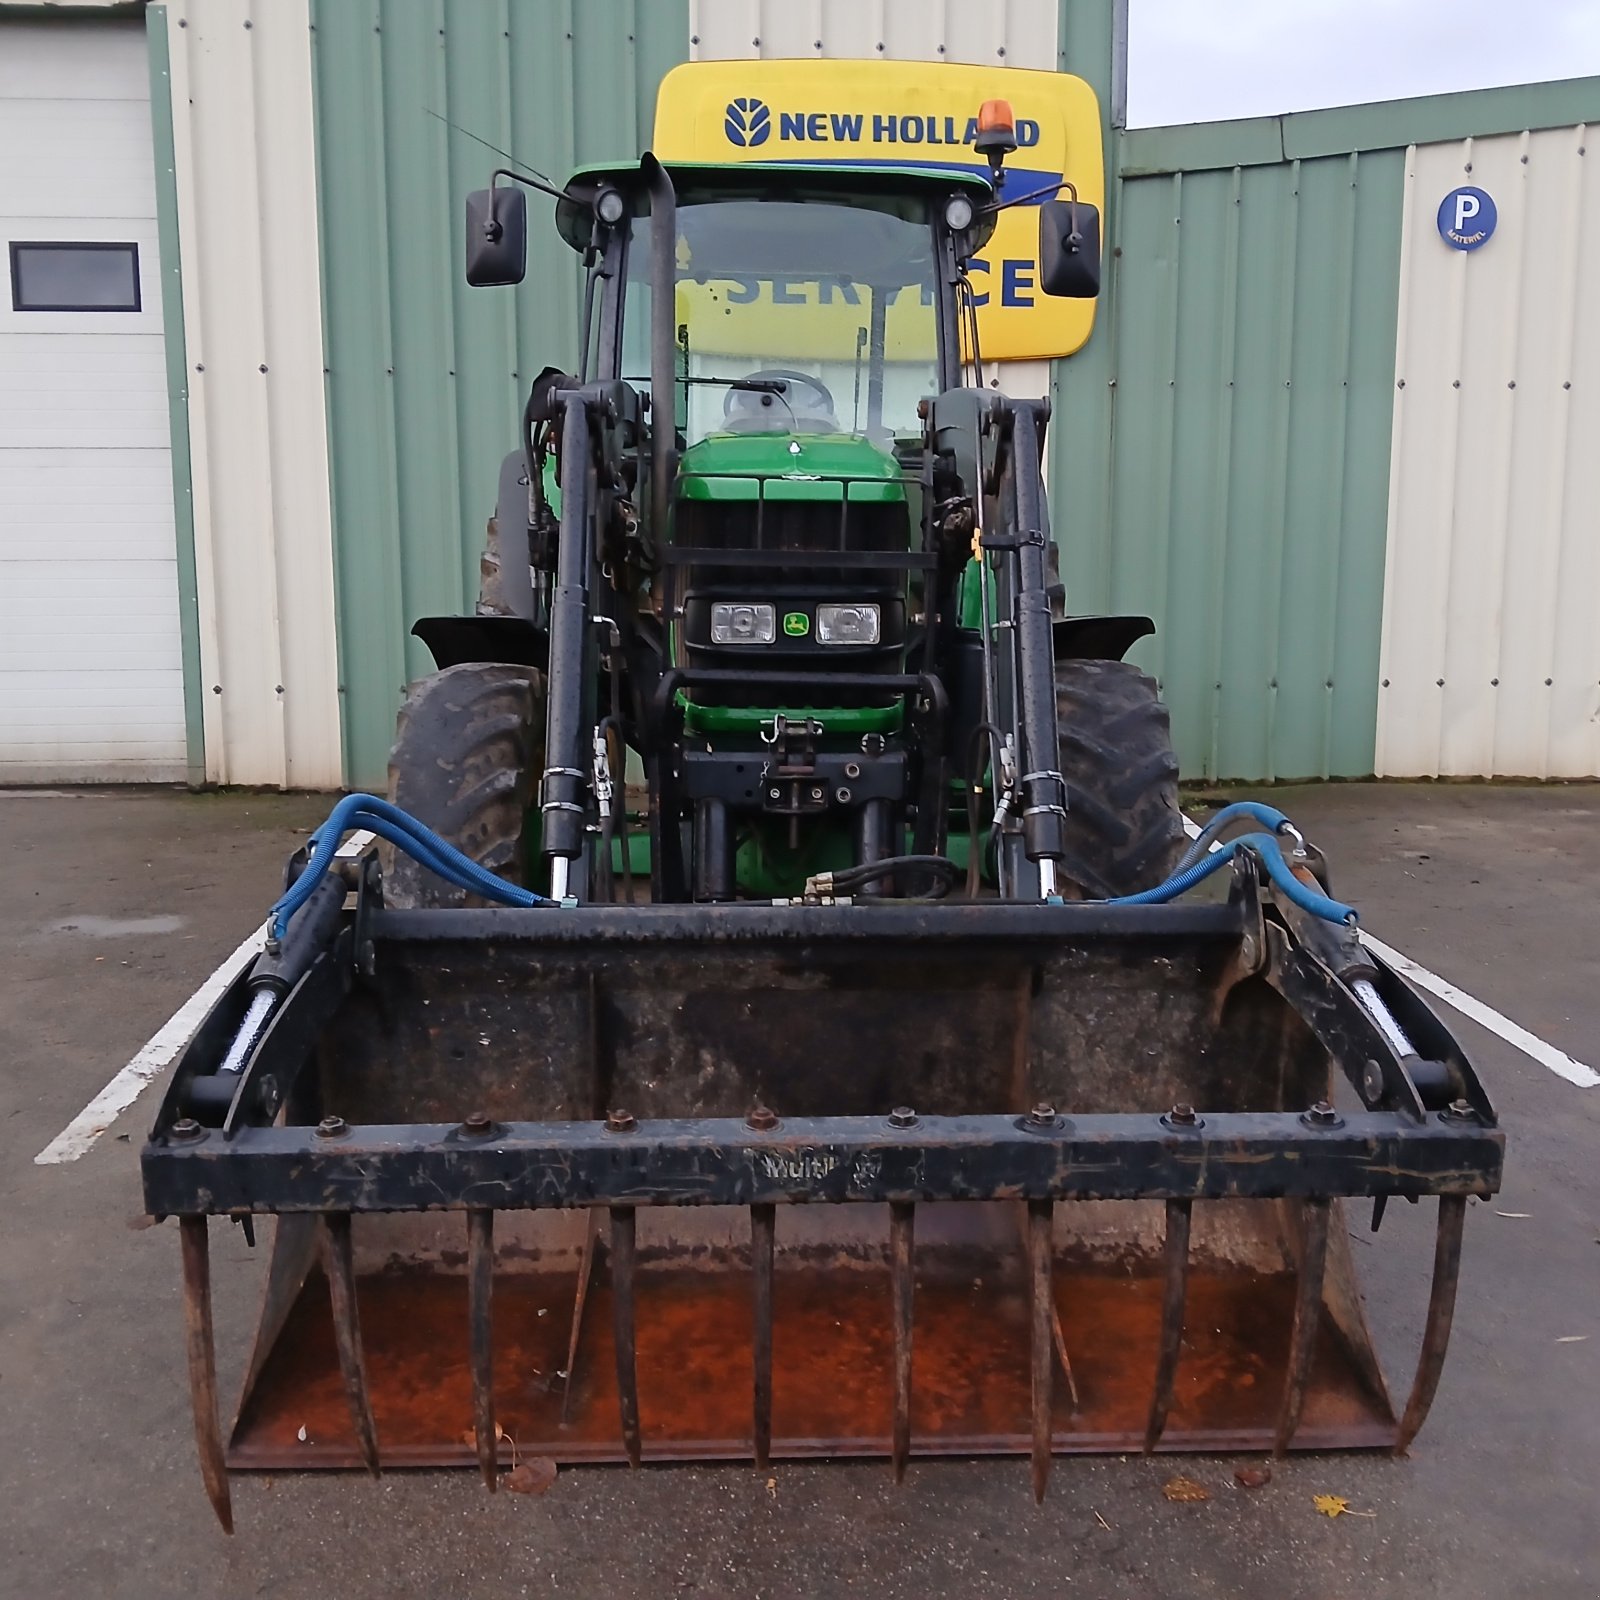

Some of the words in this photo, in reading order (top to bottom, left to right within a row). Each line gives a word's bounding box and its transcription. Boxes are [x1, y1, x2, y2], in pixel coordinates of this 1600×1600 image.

[780, 112, 863, 142] NEW
[872, 115, 1040, 147] HOLLAD
[1455, 194, 1480, 230] P
[1447, 229, 1486, 244] MATERIEL
[726, 259, 1035, 306] SERCE
